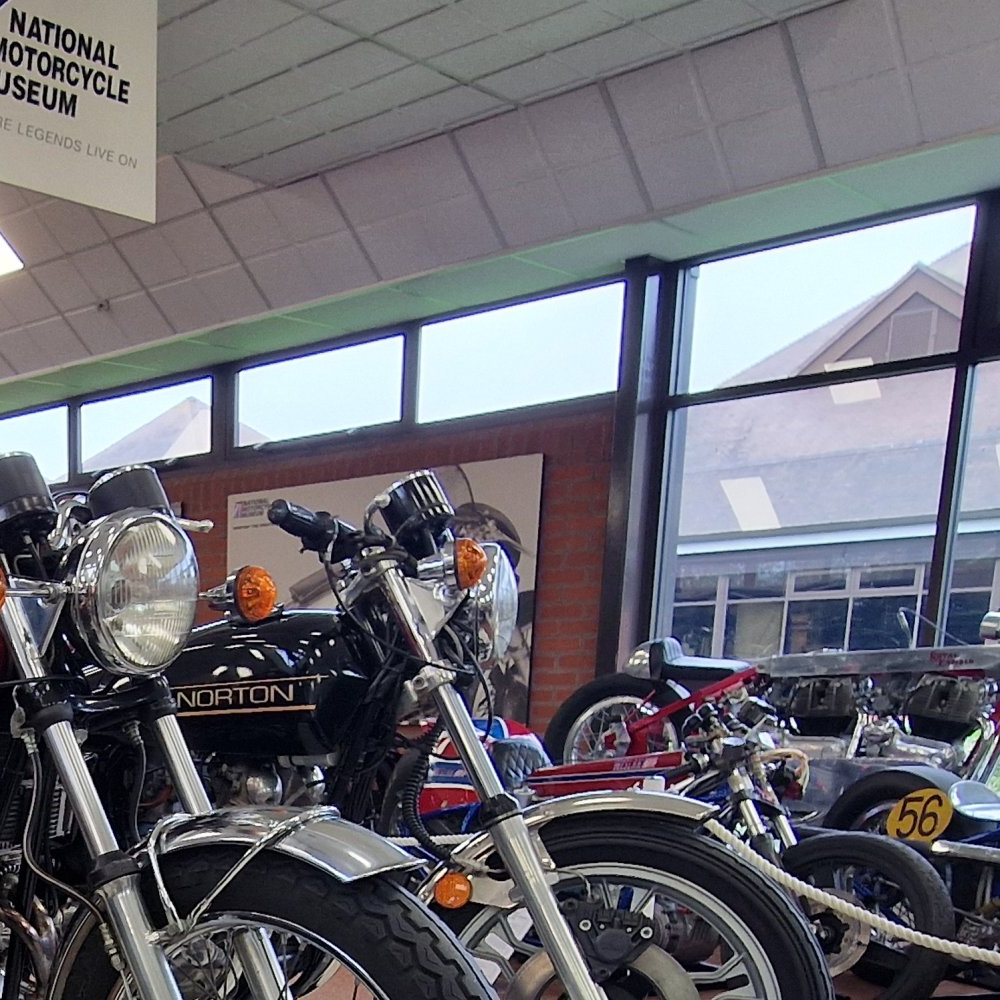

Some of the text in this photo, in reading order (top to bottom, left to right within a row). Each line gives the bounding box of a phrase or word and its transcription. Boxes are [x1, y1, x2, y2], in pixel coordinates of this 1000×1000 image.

[9, 7, 119, 70] NATIONAL
[17, 122, 82, 152] LEGENDS
[86, 144, 114, 163] LIVE
[118, 153, 138, 169] ON
[177, 683, 294, 708] NORTON
[896, 794, 943, 839] 56
